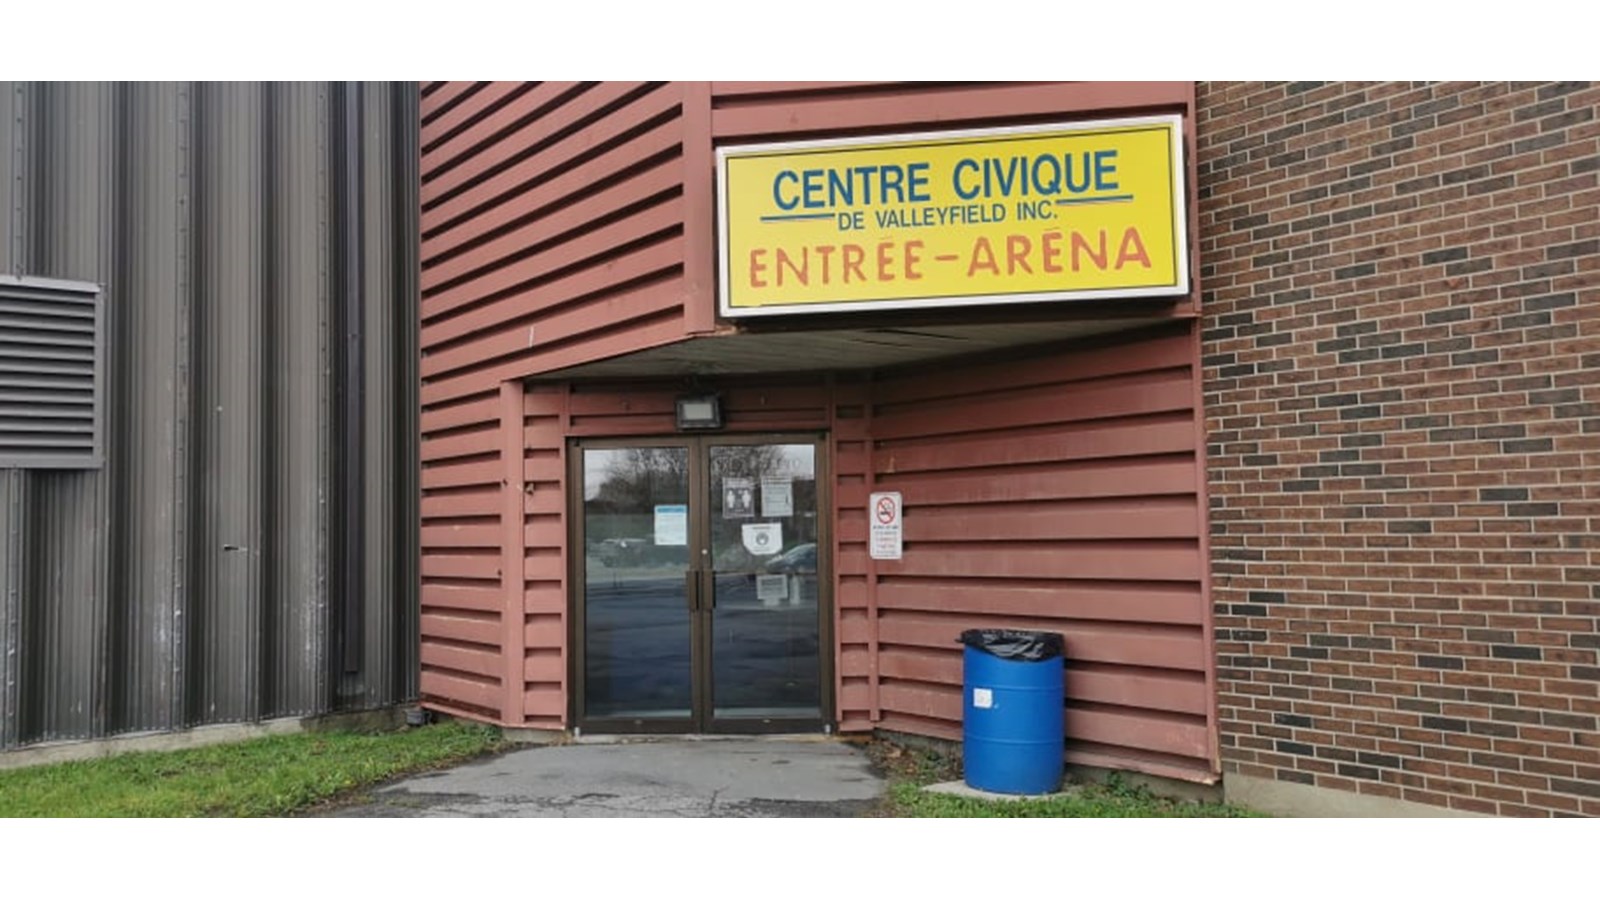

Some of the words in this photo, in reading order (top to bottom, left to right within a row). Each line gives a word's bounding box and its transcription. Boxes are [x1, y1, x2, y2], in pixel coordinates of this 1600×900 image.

[773, 162, 931, 210] CENTRE
[952, 150, 1119, 200] CIVIQUE
[838, 212, 865, 231] DE
[875, 203, 1006, 229] VALLEYFIELD
[1016, 200, 1059, 221] INC.
